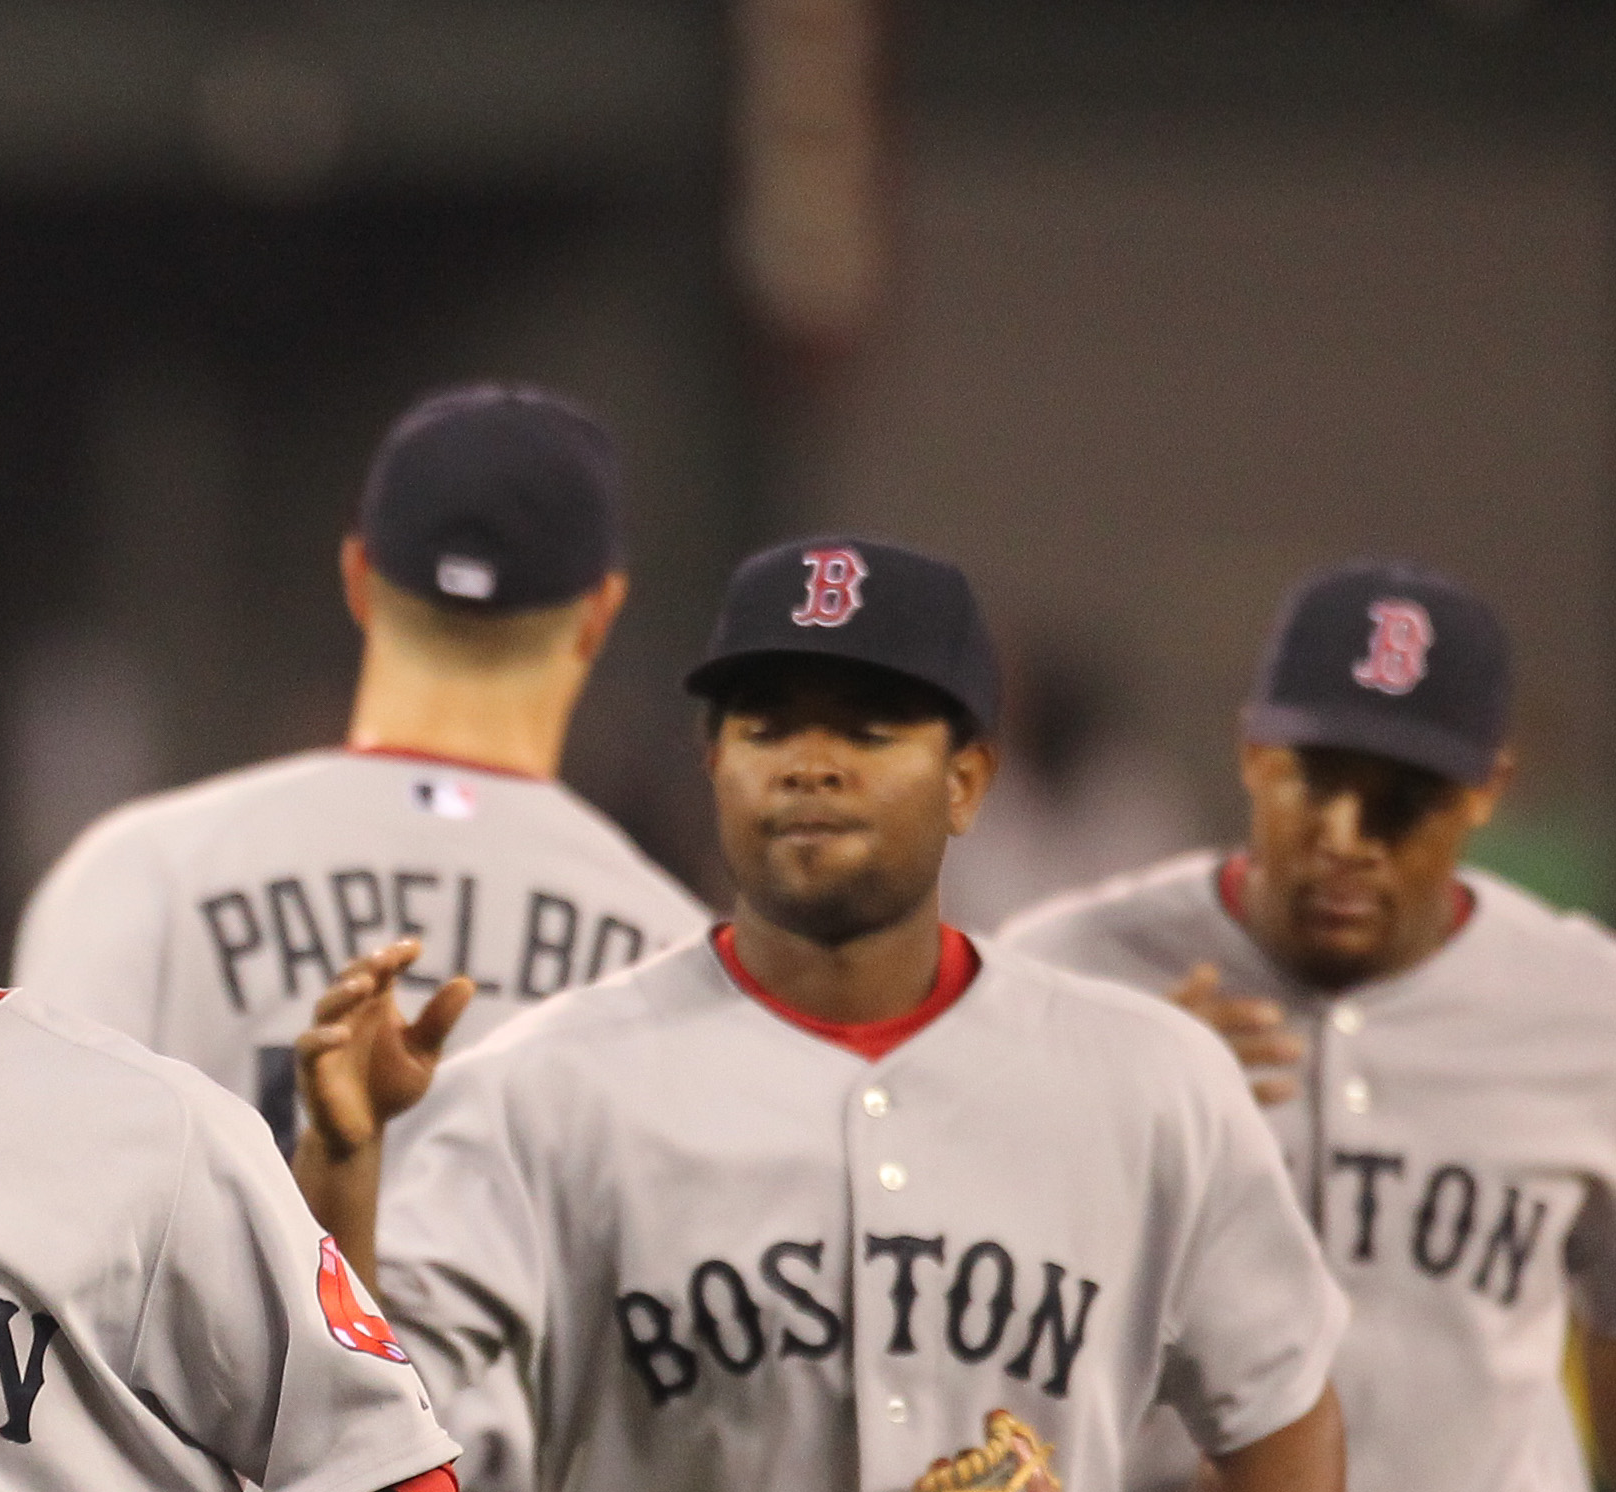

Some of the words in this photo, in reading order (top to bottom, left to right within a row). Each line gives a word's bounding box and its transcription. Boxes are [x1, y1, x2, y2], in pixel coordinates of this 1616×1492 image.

[790, 547, 868, 627] B
[1352, 599, 1434, 695] B
[199, 868, 643, 1014] PAPELBO
[1333, 1150, 1547, 1305] TON
[617, 1235, 1099, 1405] BOSTON
